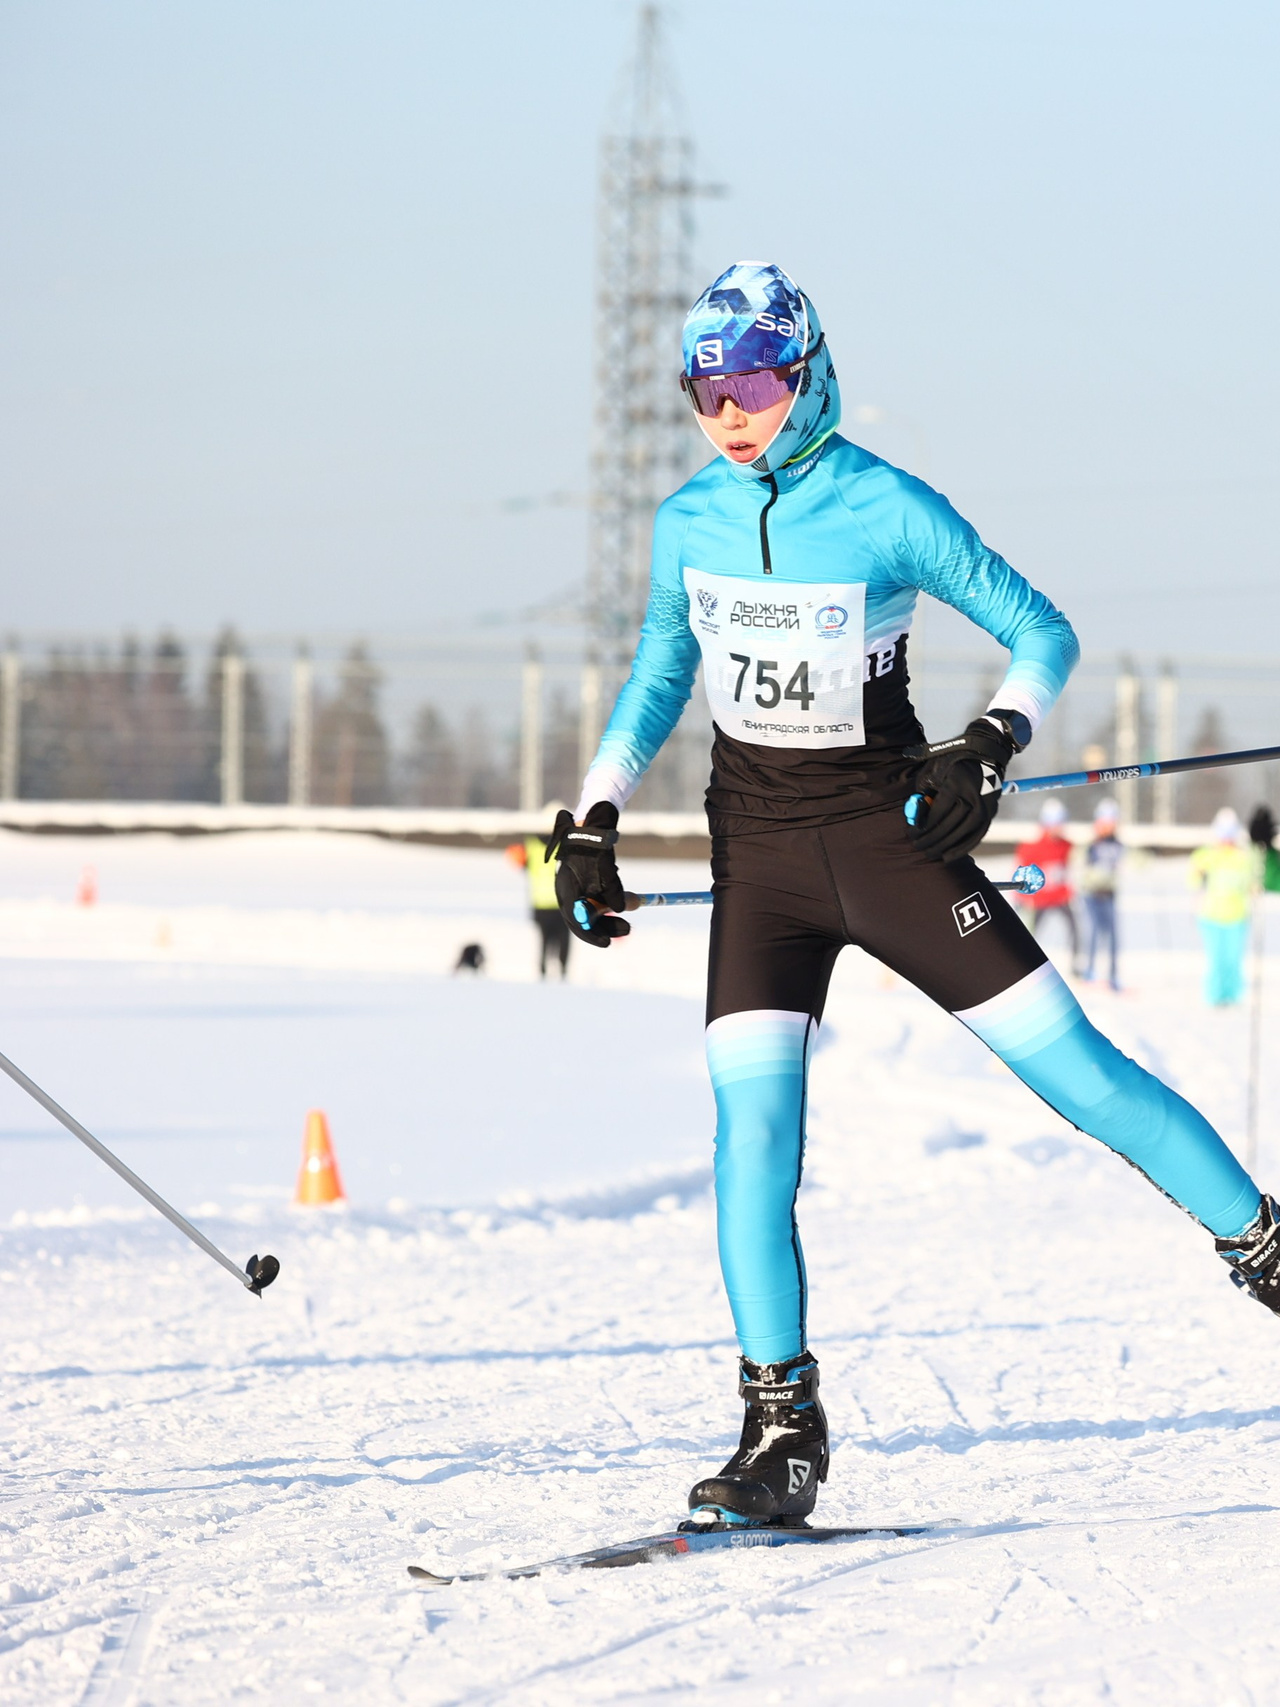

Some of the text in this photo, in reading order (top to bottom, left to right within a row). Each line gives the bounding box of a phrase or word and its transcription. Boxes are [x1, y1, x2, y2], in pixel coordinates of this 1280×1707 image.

[698, 340, 721, 367] S
[732, 600, 797, 617] ЛЫЖНЯ
[730, 612, 800, 630] РОССИИ
[729, 652, 815, 711] 754
[741, 719, 854, 734] ЛЕНИНГРАДСКАЯ ОБЛАСТЬ
[790, 1462, 809, 1491] S
